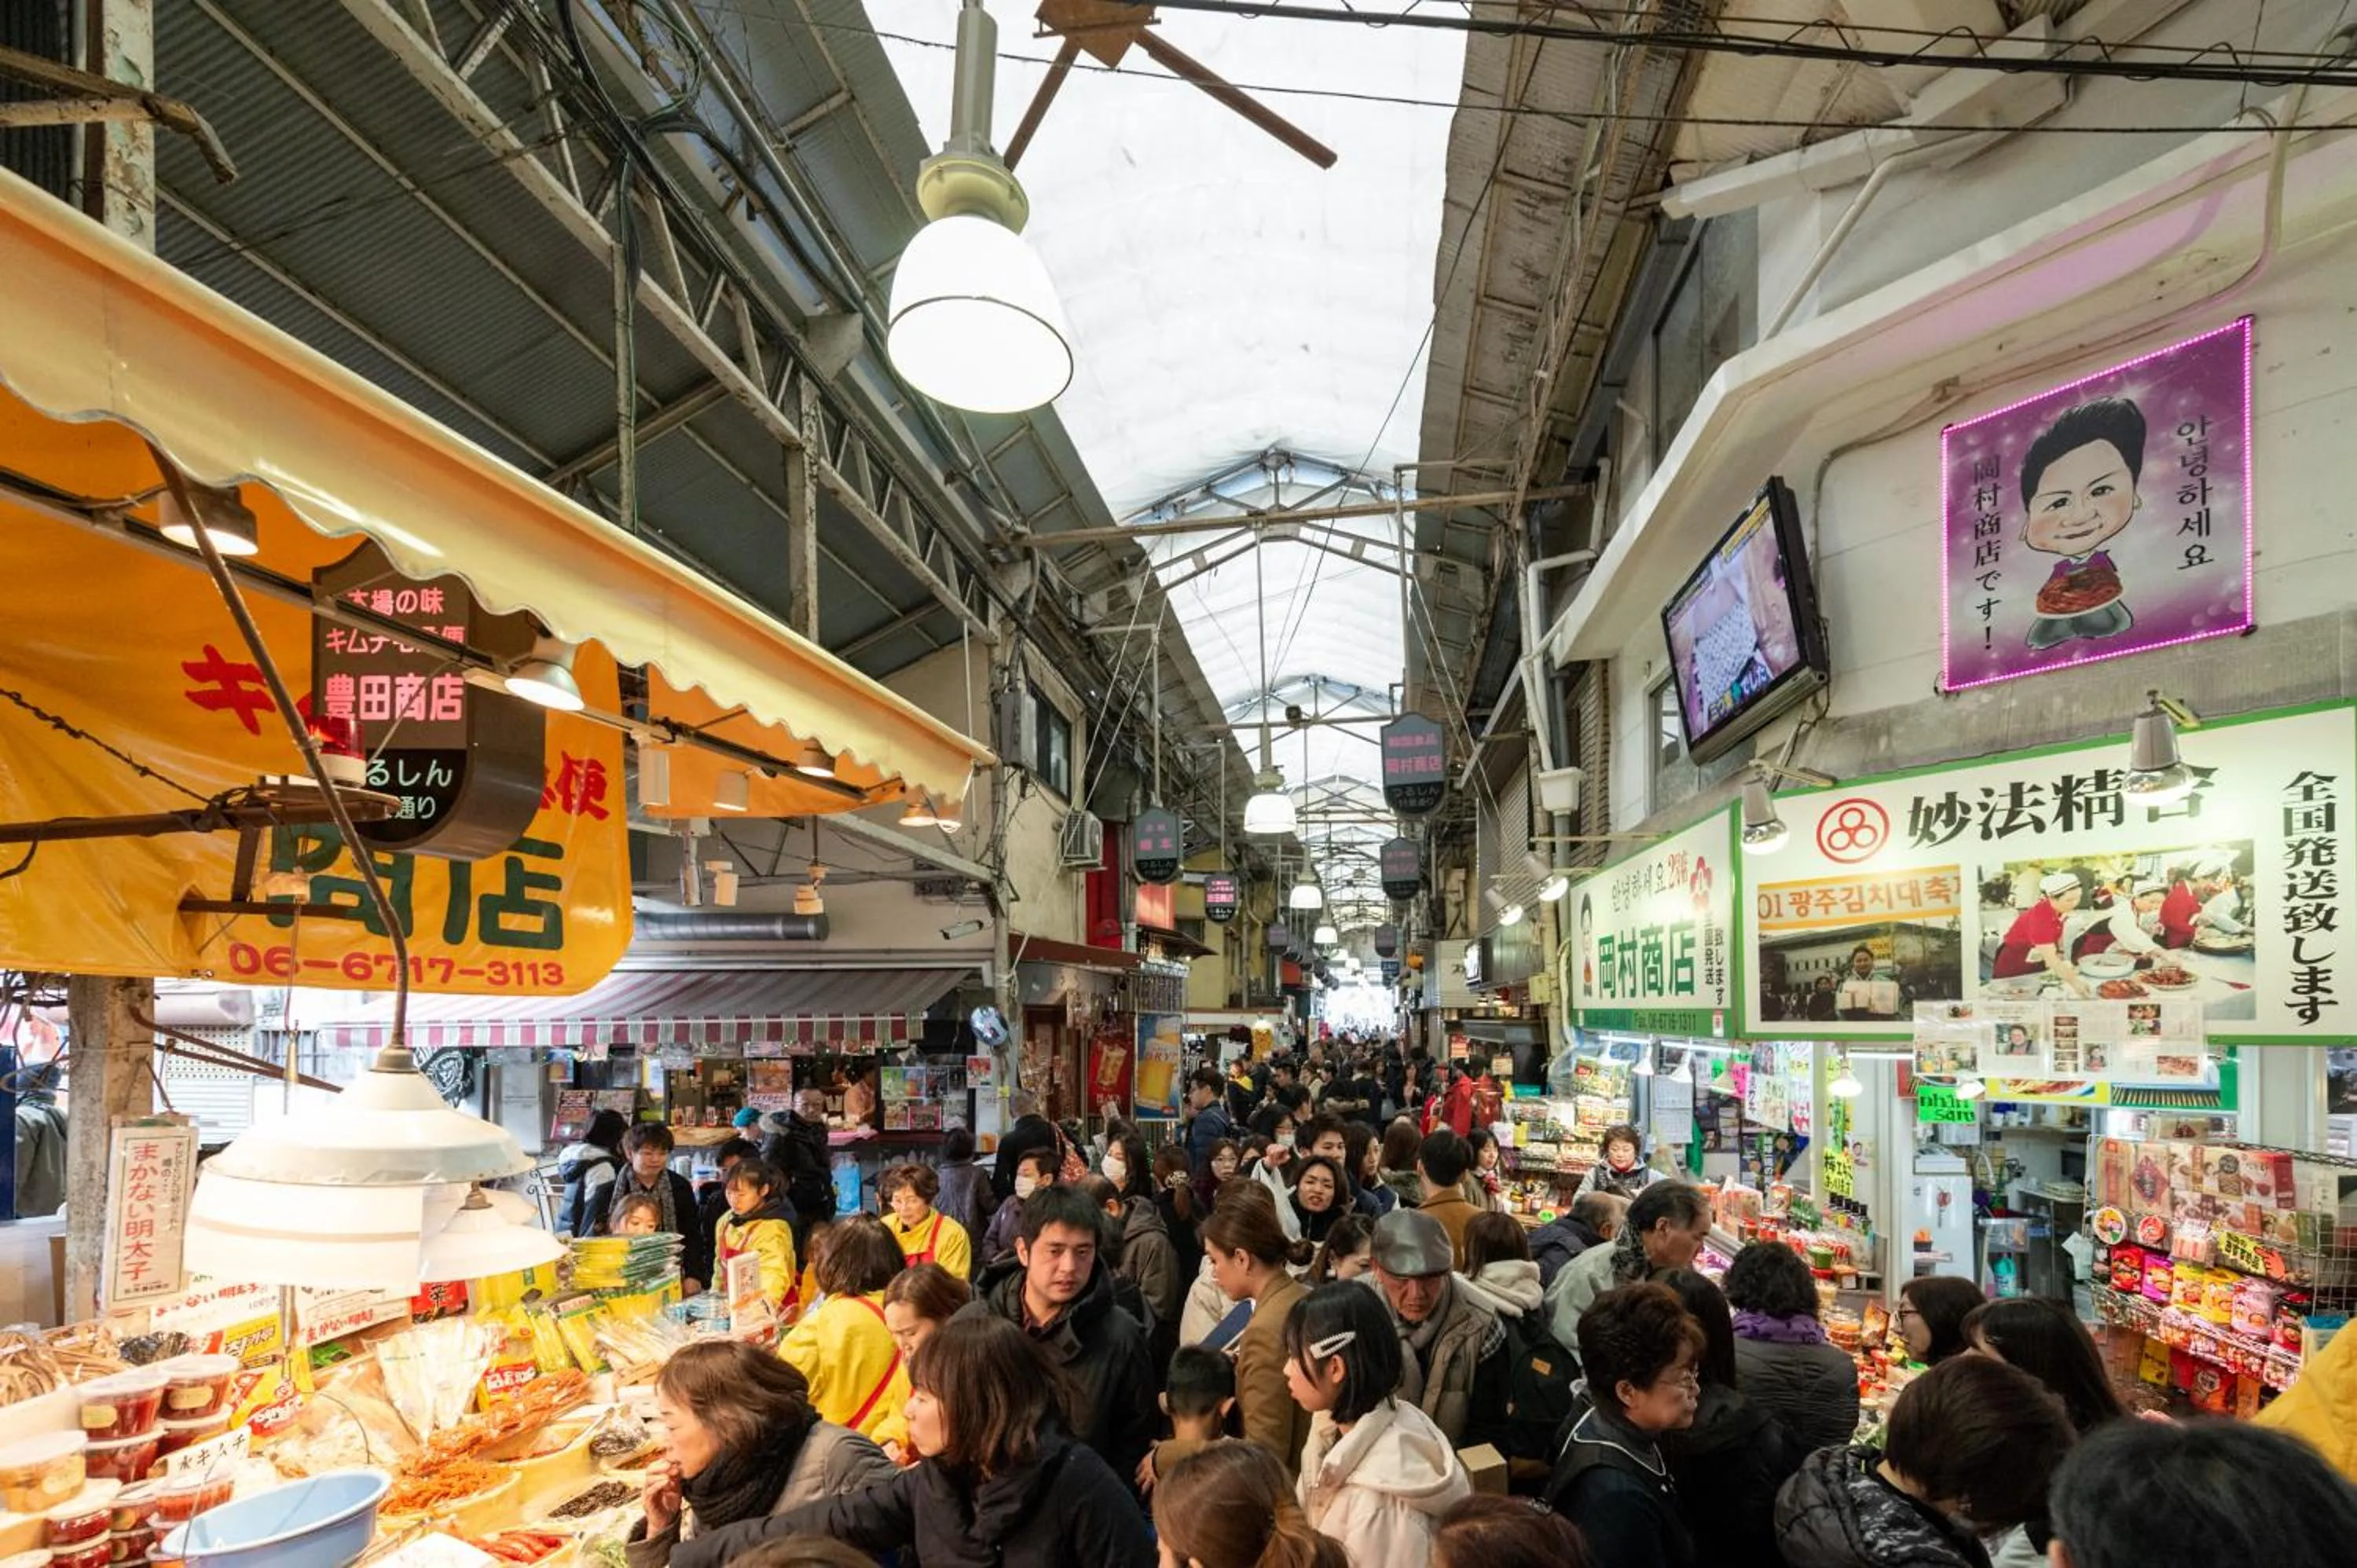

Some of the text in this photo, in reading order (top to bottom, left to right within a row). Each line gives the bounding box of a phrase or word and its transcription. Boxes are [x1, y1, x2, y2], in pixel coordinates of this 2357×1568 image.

[2176, 415, 2215, 571] 안녕하세요
[324, 672, 465, 722] 豊田商店
[366, 758, 453, 786] るしん
[383, 795, 436, 819] 通り
[2282, 771, 2339, 1027] 全国発送致します
[229, 943, 564, 986] 06-6717-3113
[1597, 921, 1696, 998] 岡村商店
[121, 1143, 159, 1281] まかない明太子
